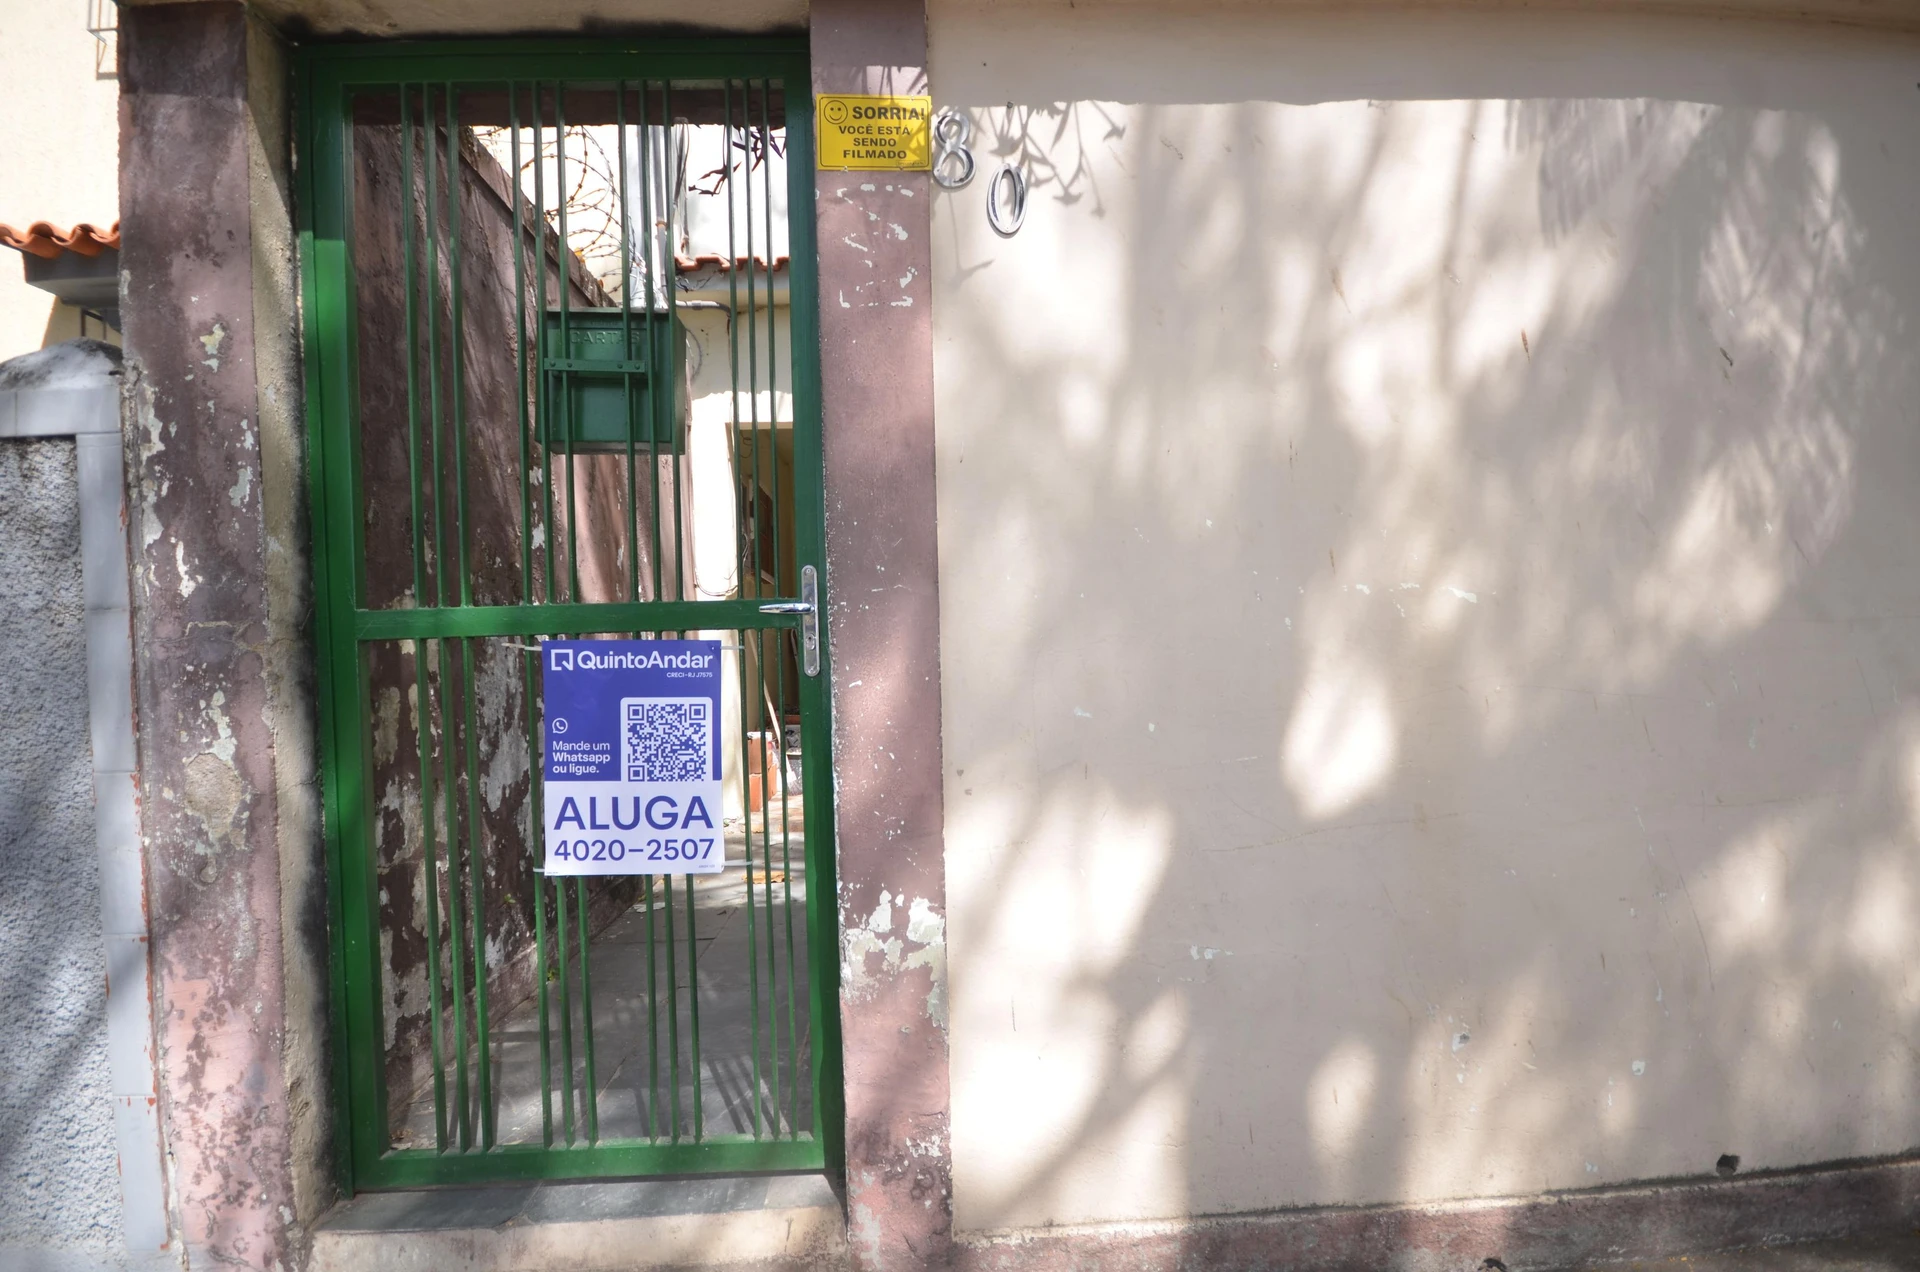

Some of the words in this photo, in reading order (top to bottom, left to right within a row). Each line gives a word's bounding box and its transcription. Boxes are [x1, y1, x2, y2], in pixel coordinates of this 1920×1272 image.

[852, 106, 925, 121] SORRIA!
[839, 124, 873, 135] VOCÊ
[877, 124, 911, 136] ESTÁ
[853, 137, 897, 147] SENDO
[843, 149, 907, 160] FILMADO
[577, 650, 713, 670] QuintoAndar
[552, 740, 591, 751] Mande
[592, 743, 610, 751] um
[552, 752, 611, 764] Whatsapp
[552, 765, 567, 774] ou
[569, 763, 600, 776] ligue.
[553, 795, 714, 831] ALUGA
[554, 838, 715, 861] 4020-2507
